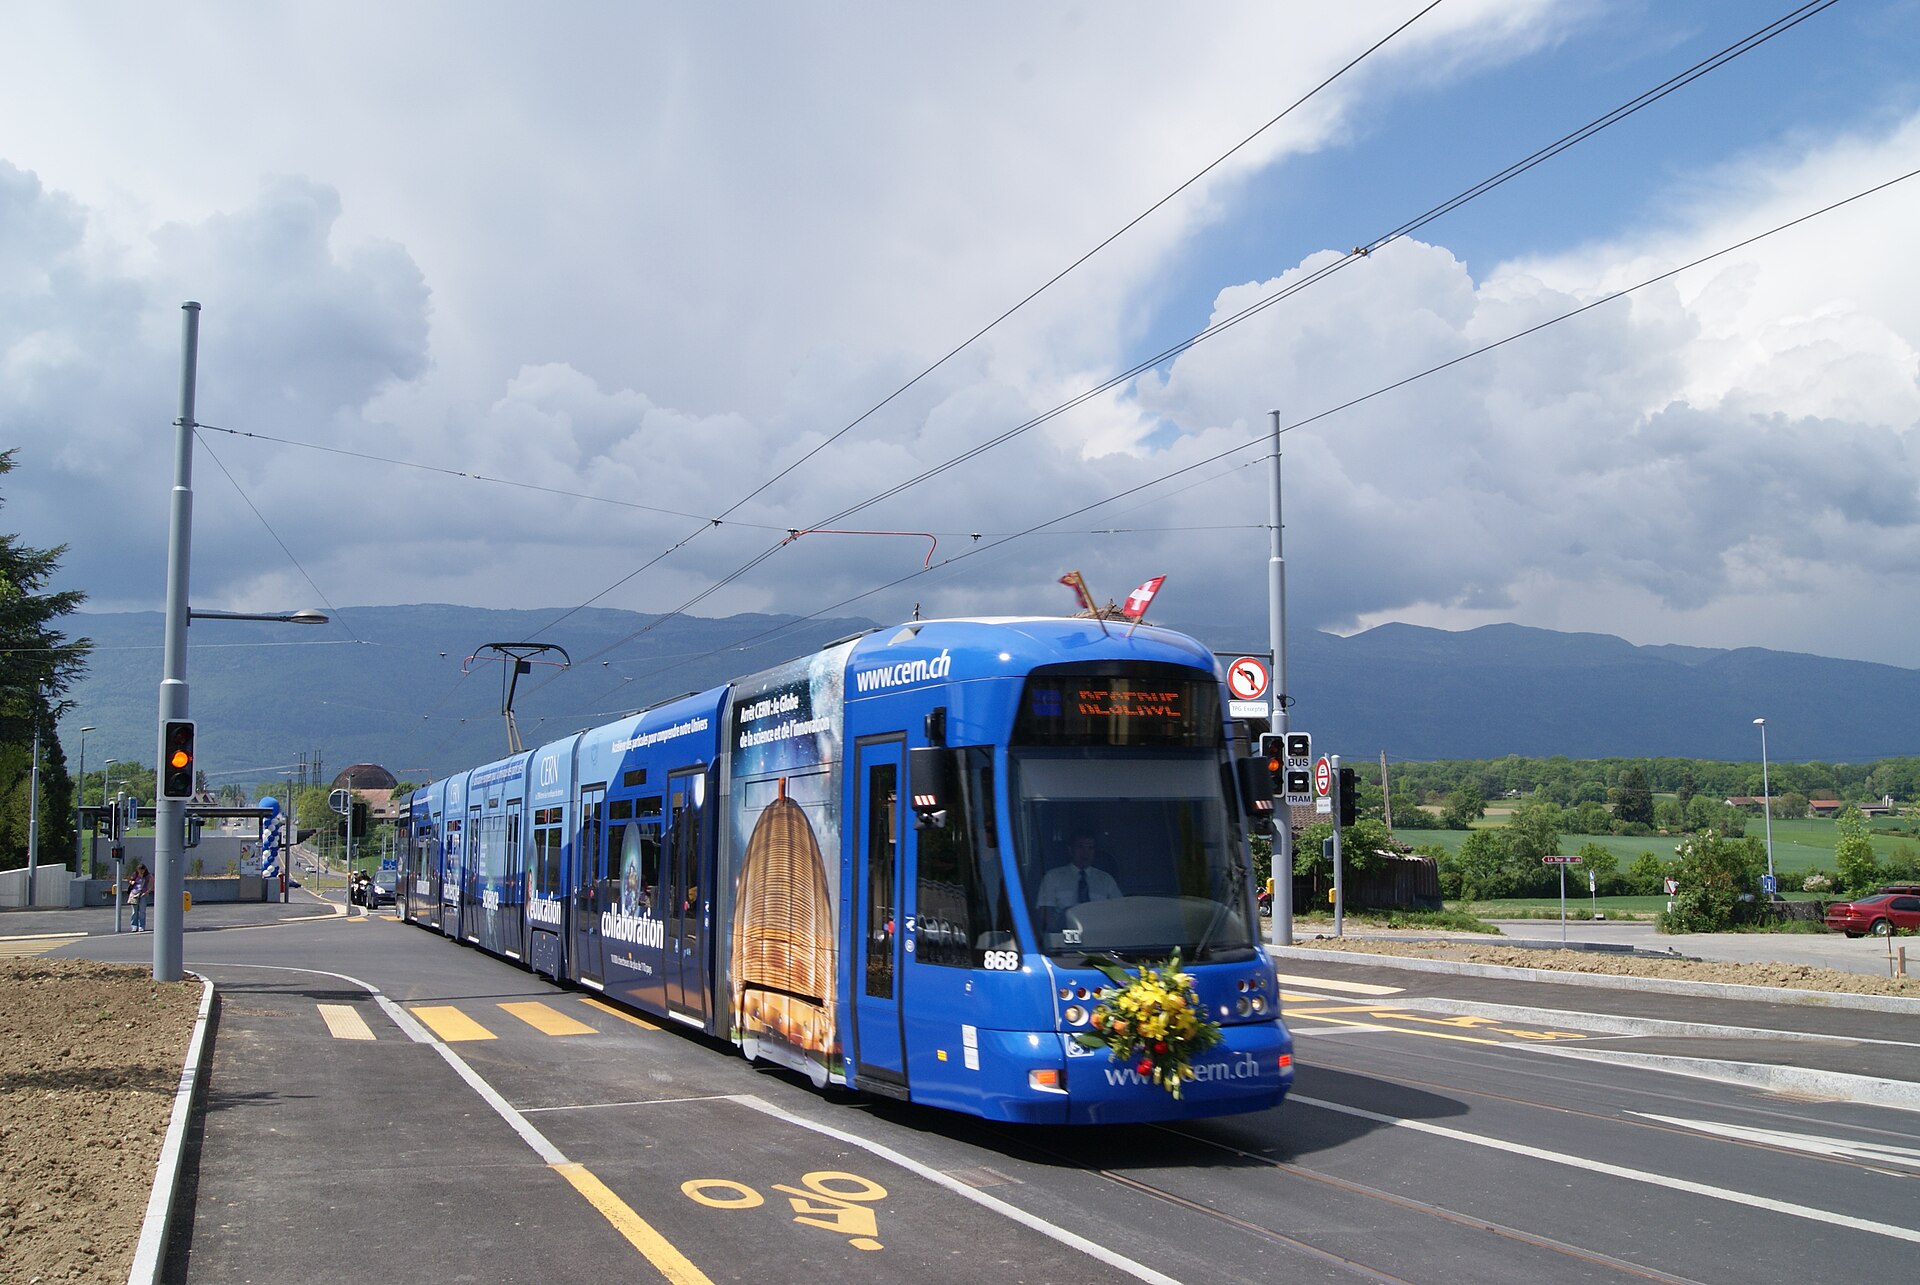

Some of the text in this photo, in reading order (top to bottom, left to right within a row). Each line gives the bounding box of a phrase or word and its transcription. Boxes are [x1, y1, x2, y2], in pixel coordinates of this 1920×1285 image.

[856, 648, 951, 692] www.cern.ch
[740, 705, 755, 723] Arrêt
[779, 693, 799, 713] Globe
[690, 717, 708, 733] Univers
[740, 731, 748, 748] de
[747, 730, 753, 746] la
[753, 729, 773, 745] science
[774, 725, 781, 740] et
[781, 721, 790, 739] de
[541, 754, 559, 787] CERN
[1288, 758, 1309, 767] BUS
[1287, 795, 1311, 803] TRAM
[601, 902, 664, 950] collaboration
[983, 950, 1019, 971] 868
